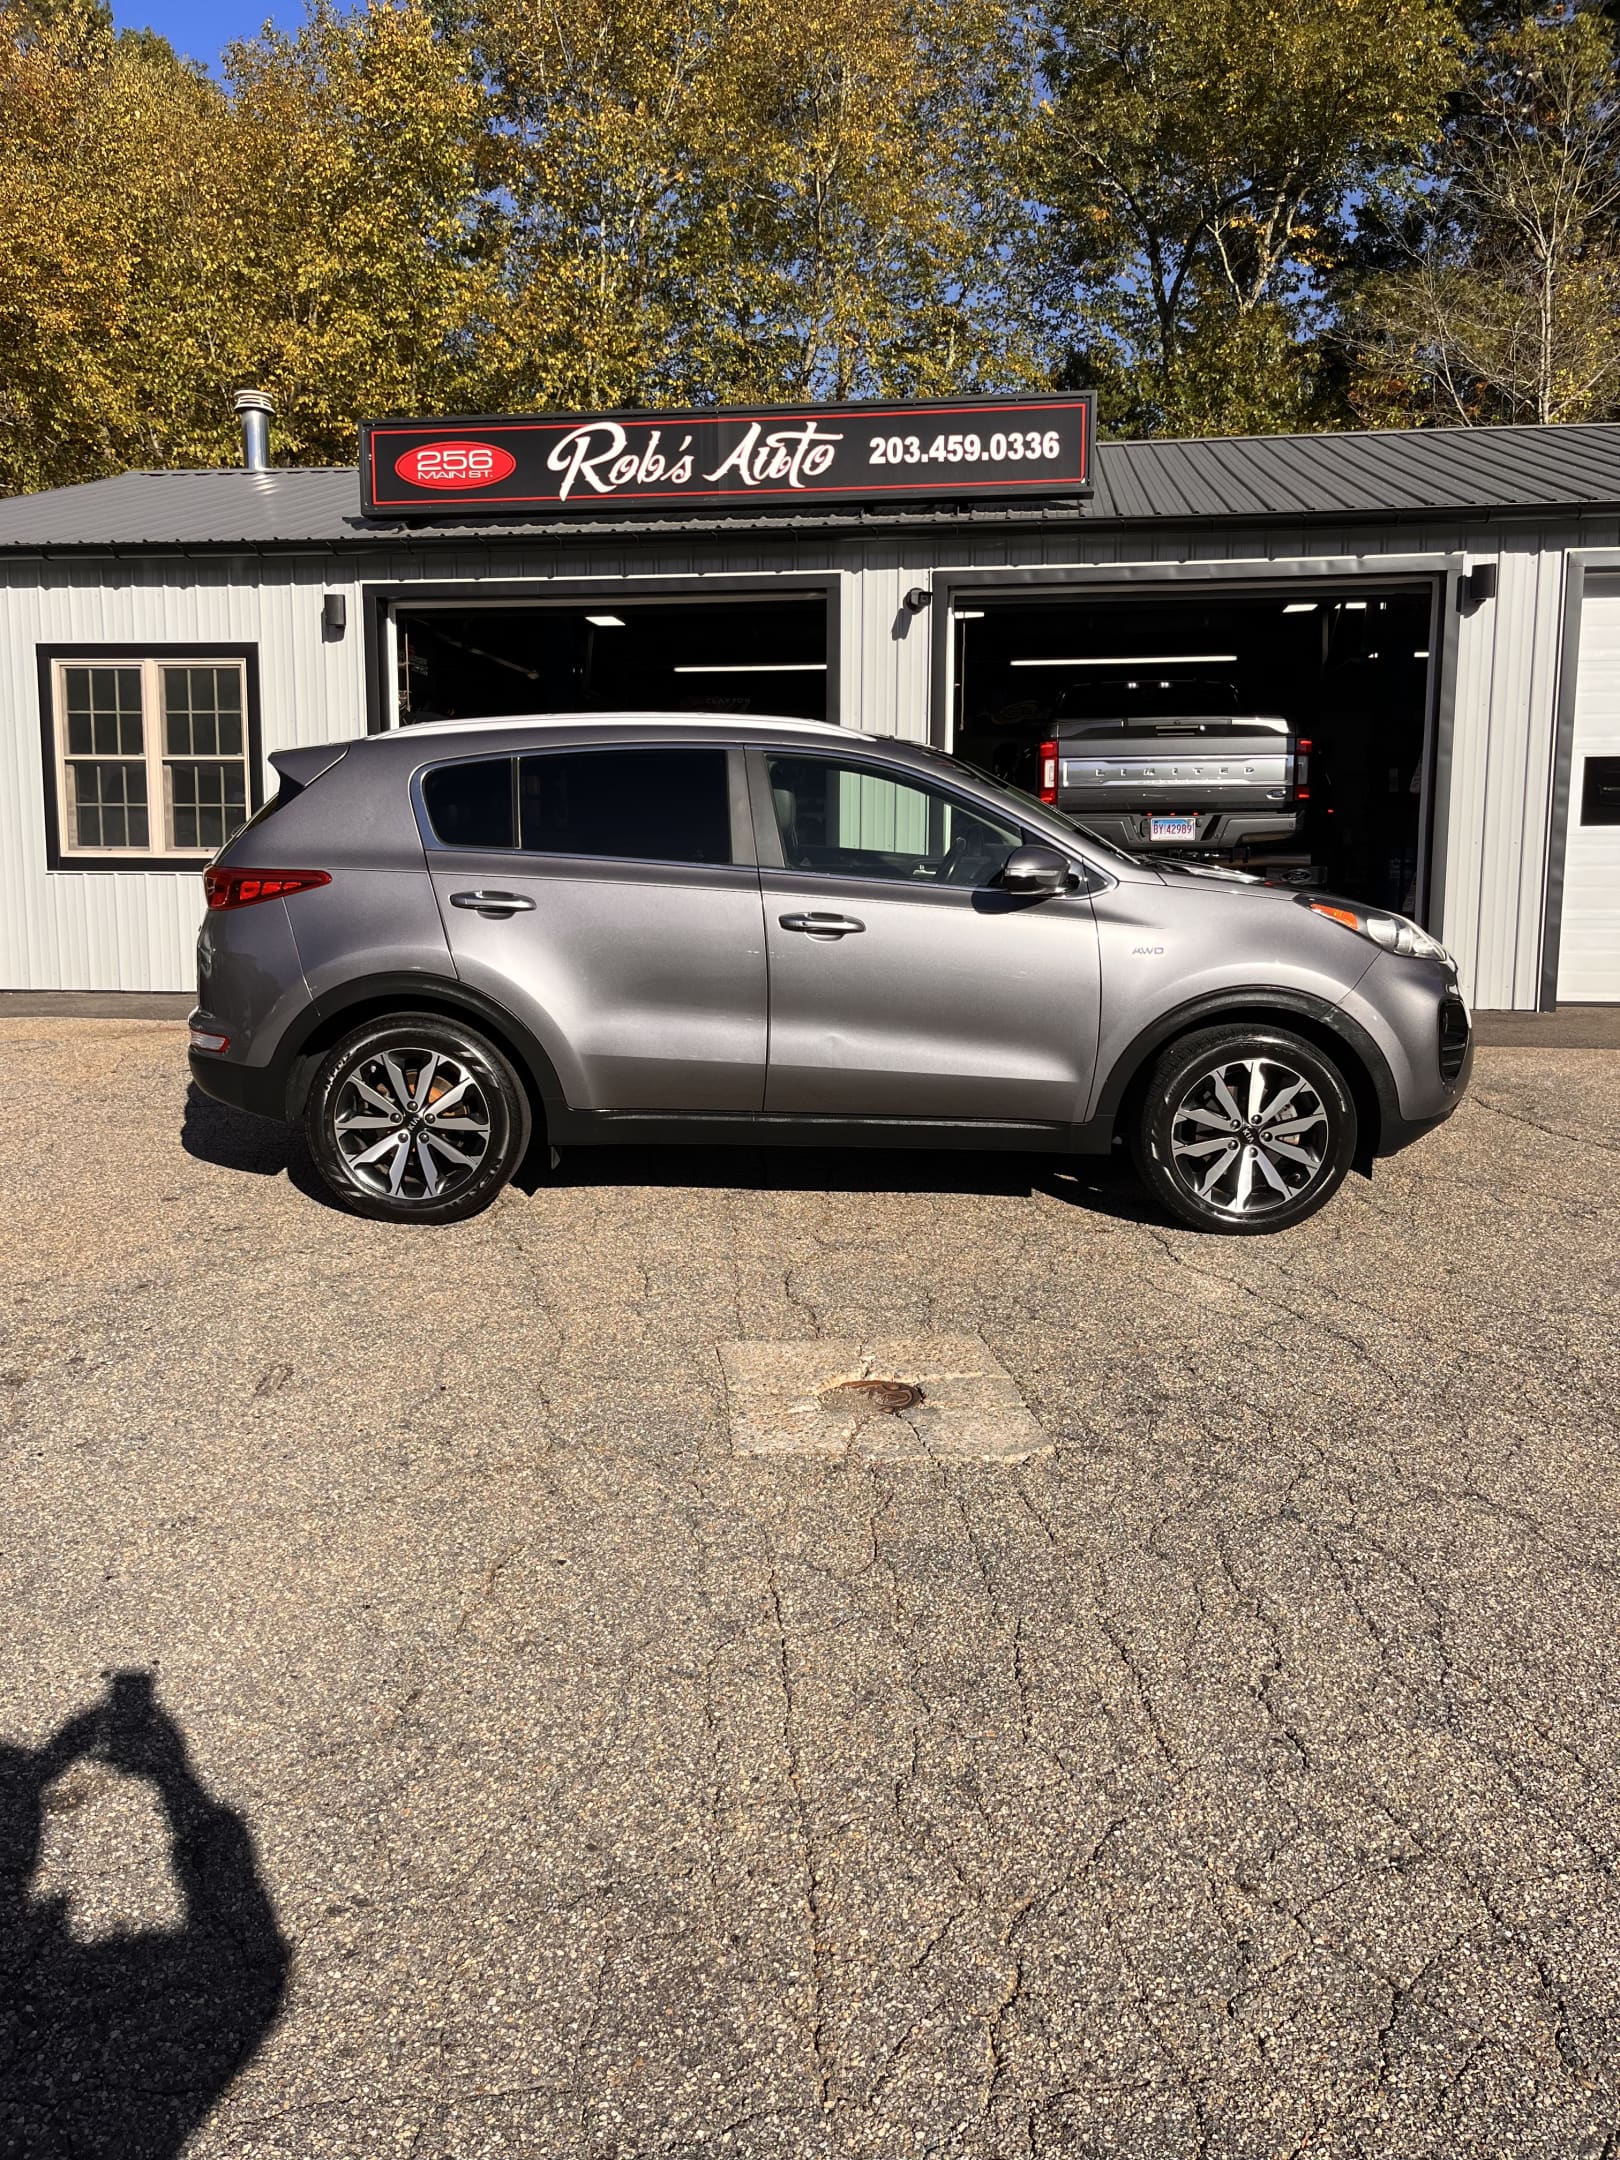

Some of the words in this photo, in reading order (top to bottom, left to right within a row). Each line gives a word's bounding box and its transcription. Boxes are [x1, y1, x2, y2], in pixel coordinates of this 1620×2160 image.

[869, 431, 1061, 464] 203.459.0336
[417, 450, 493, 470] 256
[547, 422, 695, 501] Rob's
[702, 421, 844, 488] Auto
[418, 471, 466, 479] MAIN
[468, 470, 494, 478] ST.
[1132, 947, 1165, 955] AWD
[407, 1117, 420, 1131] KIA
